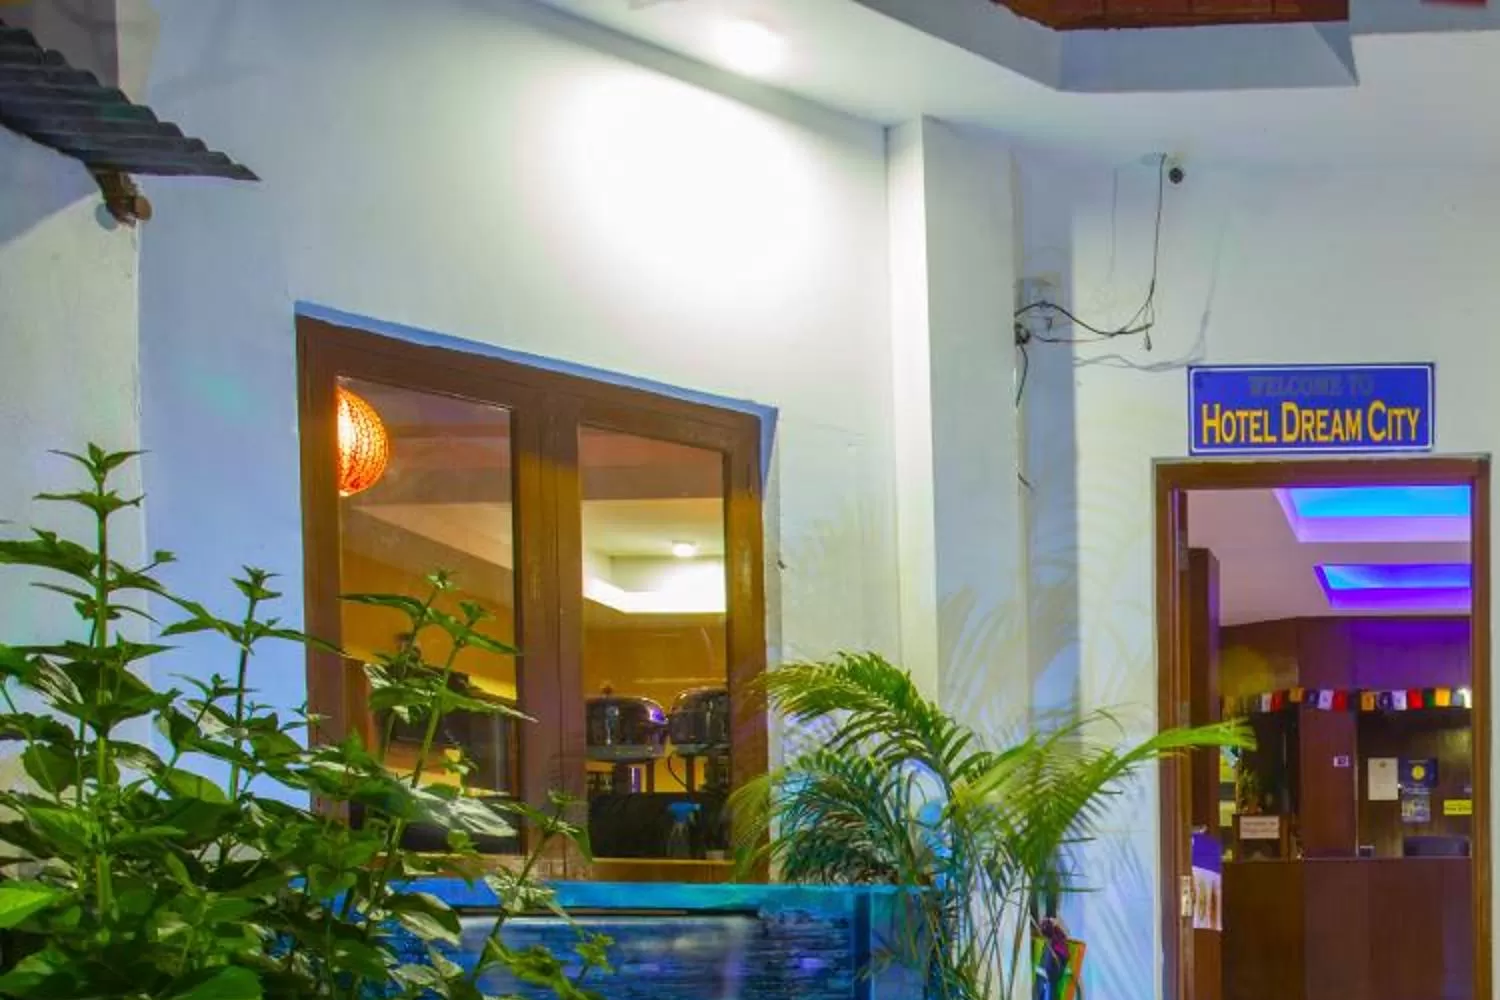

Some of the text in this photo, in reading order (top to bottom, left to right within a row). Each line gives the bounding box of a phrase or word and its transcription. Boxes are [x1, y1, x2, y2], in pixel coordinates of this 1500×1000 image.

[1201, 399, 1421, 445] HOTEL DREAM CITY
